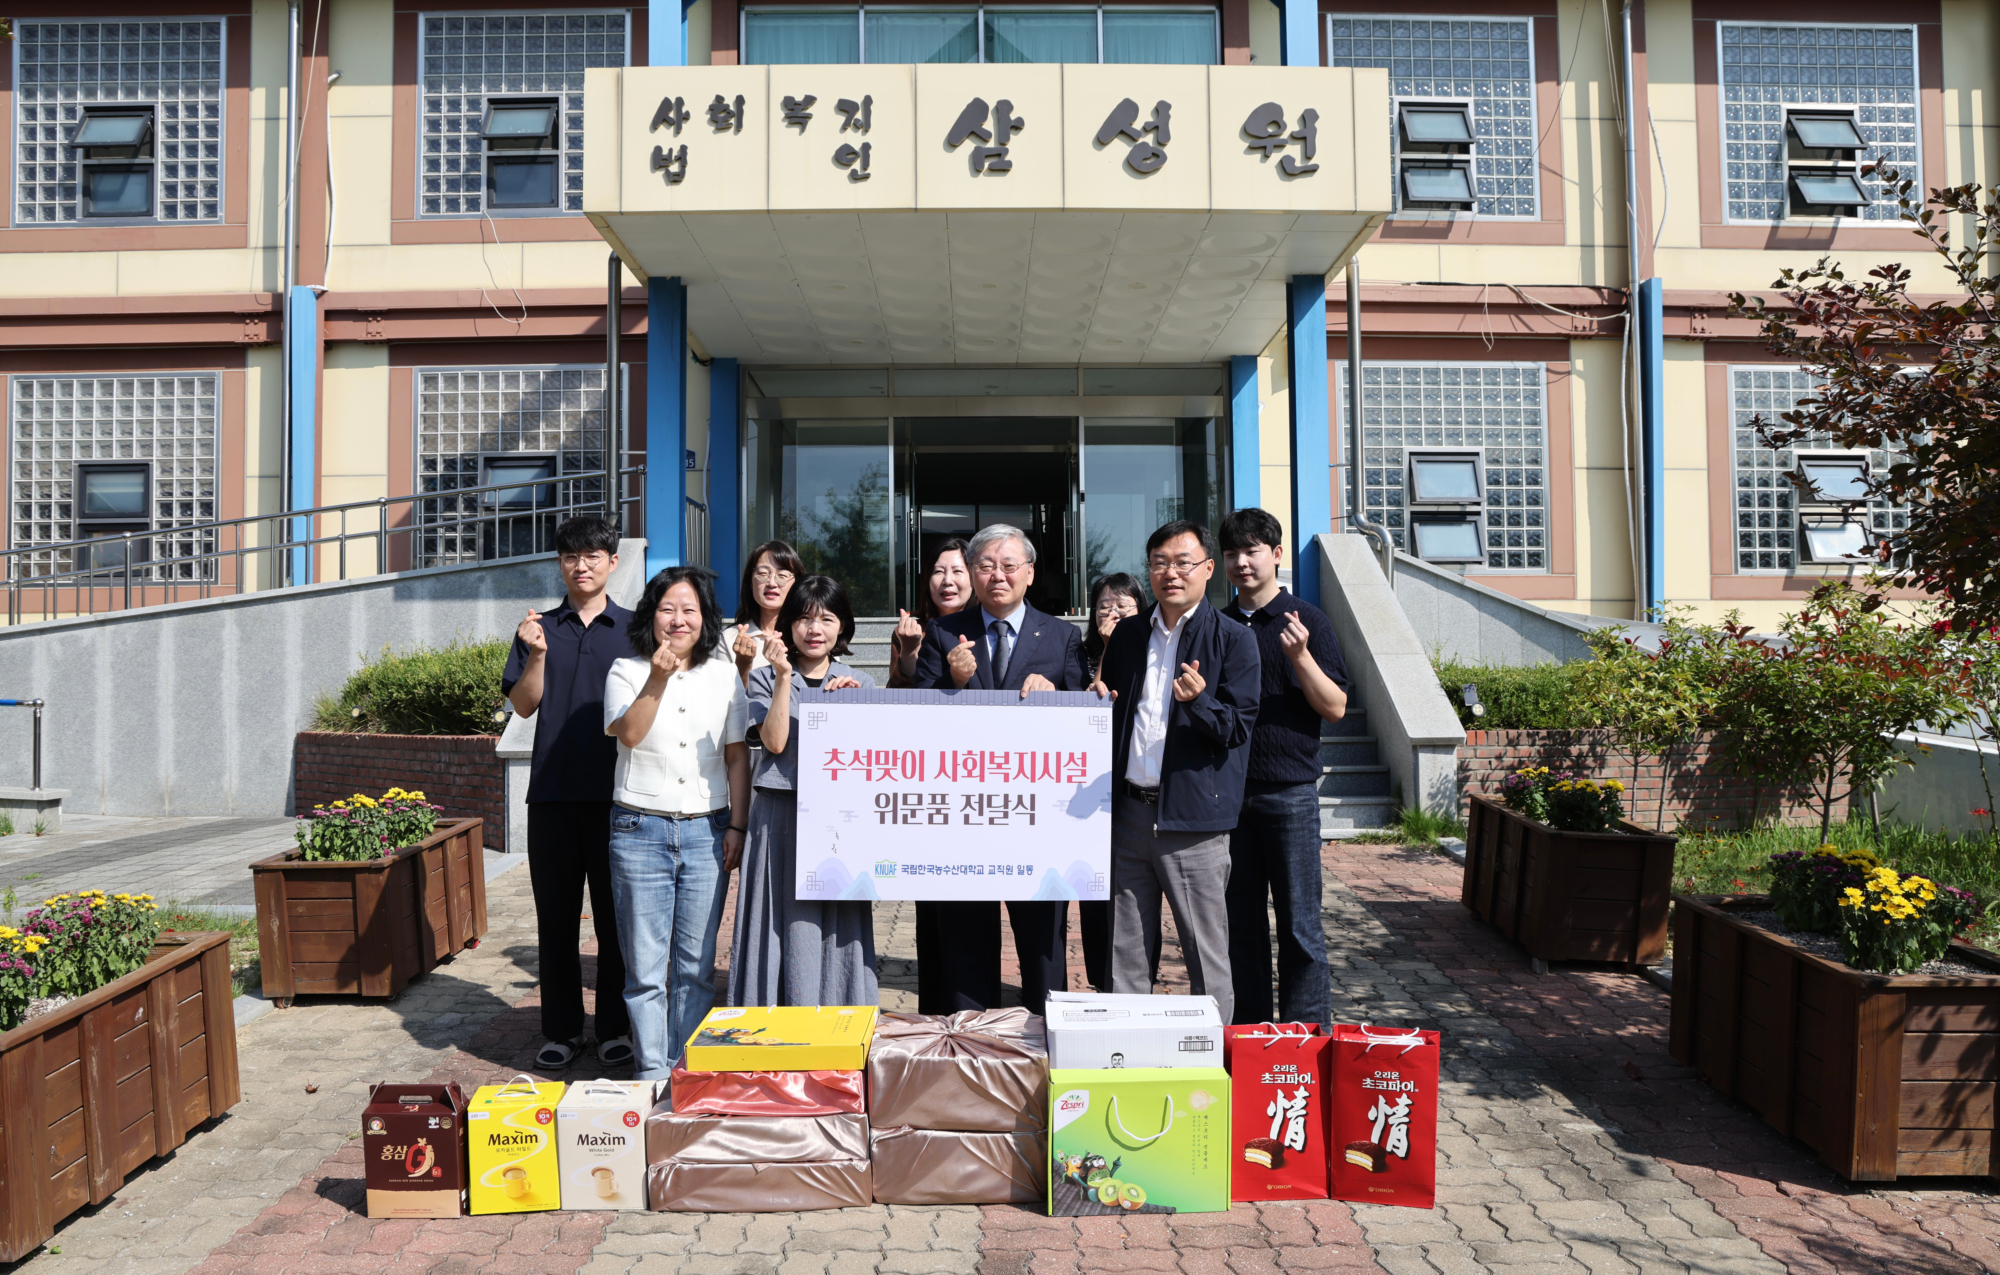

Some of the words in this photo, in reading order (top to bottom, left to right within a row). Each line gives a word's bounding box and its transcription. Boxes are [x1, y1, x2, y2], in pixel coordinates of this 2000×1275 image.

[652, 94, 872, 134] 사회복지
[945, 97, 1319, 177] 삼성원
[823, 748, 925, 782] 추석맞이
[934, 750, 1087, 783] 사회복지시설
[874, 792, 951, 825] 위문품
[960, 793, 1036, 825] 전달식
[875, 863, 897, 876] KNUAF
[901, 864, 984, 876] 국립한국농수산대학교
[988, 864, 1013, 876] 교직원
[1017, 864, 1034, 876] 일동
[1272, 1064, 1298, 1073] 오리온
[1374, 1070, 1400, 1080] 오리온
[1261, 1072, 1311, 1085] 초코파이
[1362, 1077, 1415, 1092] 초코파이
[1061, 1100, 1085, 1110] Zespri
[1267, 1085, 1310, 1151] 情
[1367, 1092, 1414, 1158] 情
[488, 1130, 539, 1146] Maxim
[577, 1131, 626, 1146] Maxim
[381, 1145, 408, 1160] 홍삼
